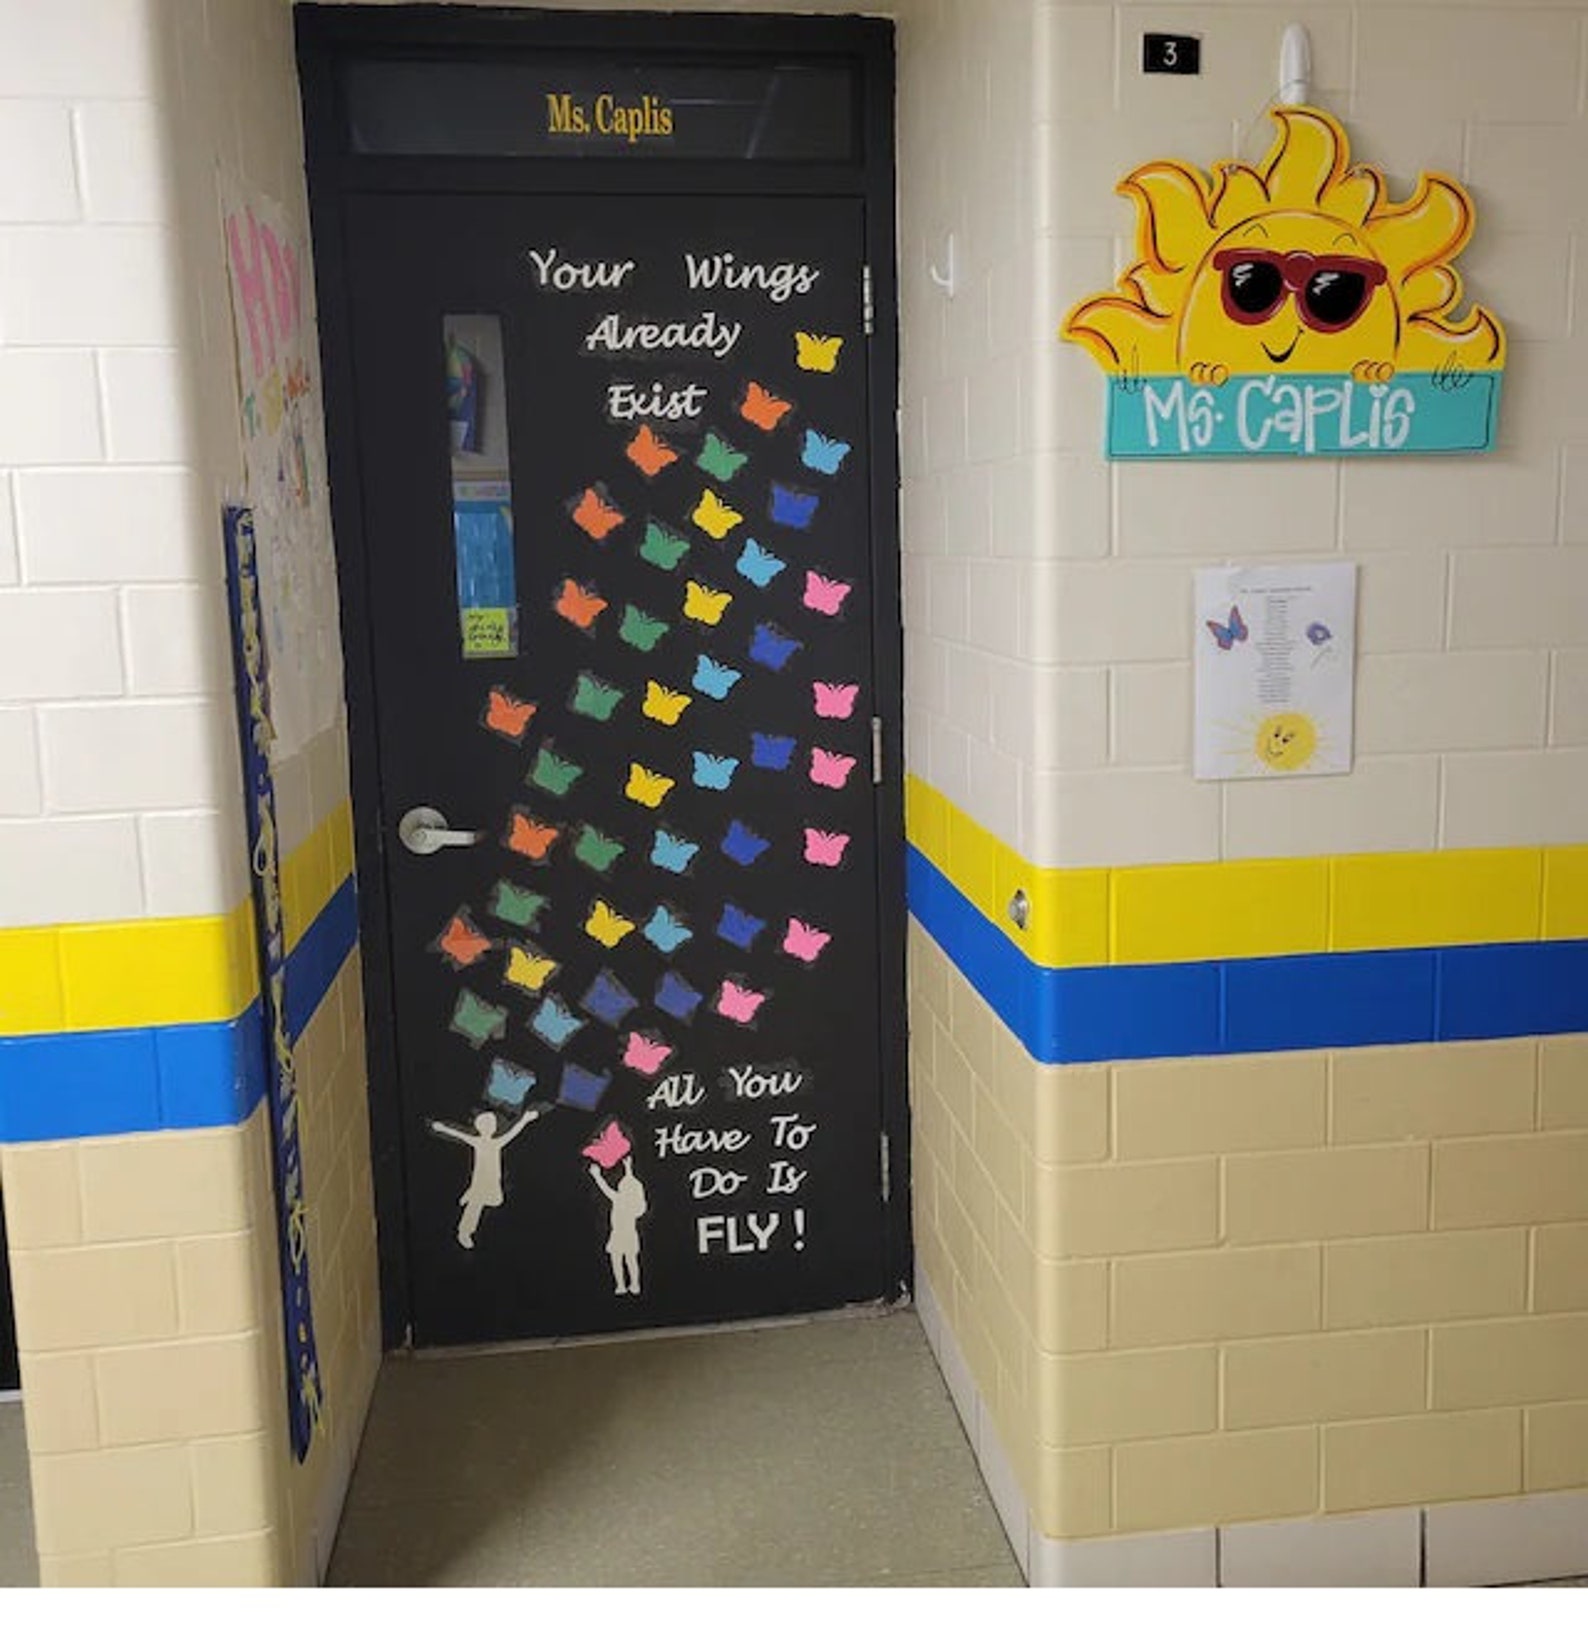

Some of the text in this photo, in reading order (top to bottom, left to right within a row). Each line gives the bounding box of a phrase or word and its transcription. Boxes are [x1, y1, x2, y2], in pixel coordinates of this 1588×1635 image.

[1163, 41, 1178, 67] 3
[546, 94, 674, 143] Ms. Caplis
[529, 249, 820, 303] Your Wings
[585, 312, 741, 358] Already
[608, 382, 708, 420] Exist
[1143, 379, 1224, 452] Ms.
[647, 1065, 803, 1110] All You
[654, 1113, 817, 1158] Have To
[689, 1160, 808, 1199] Do Is
